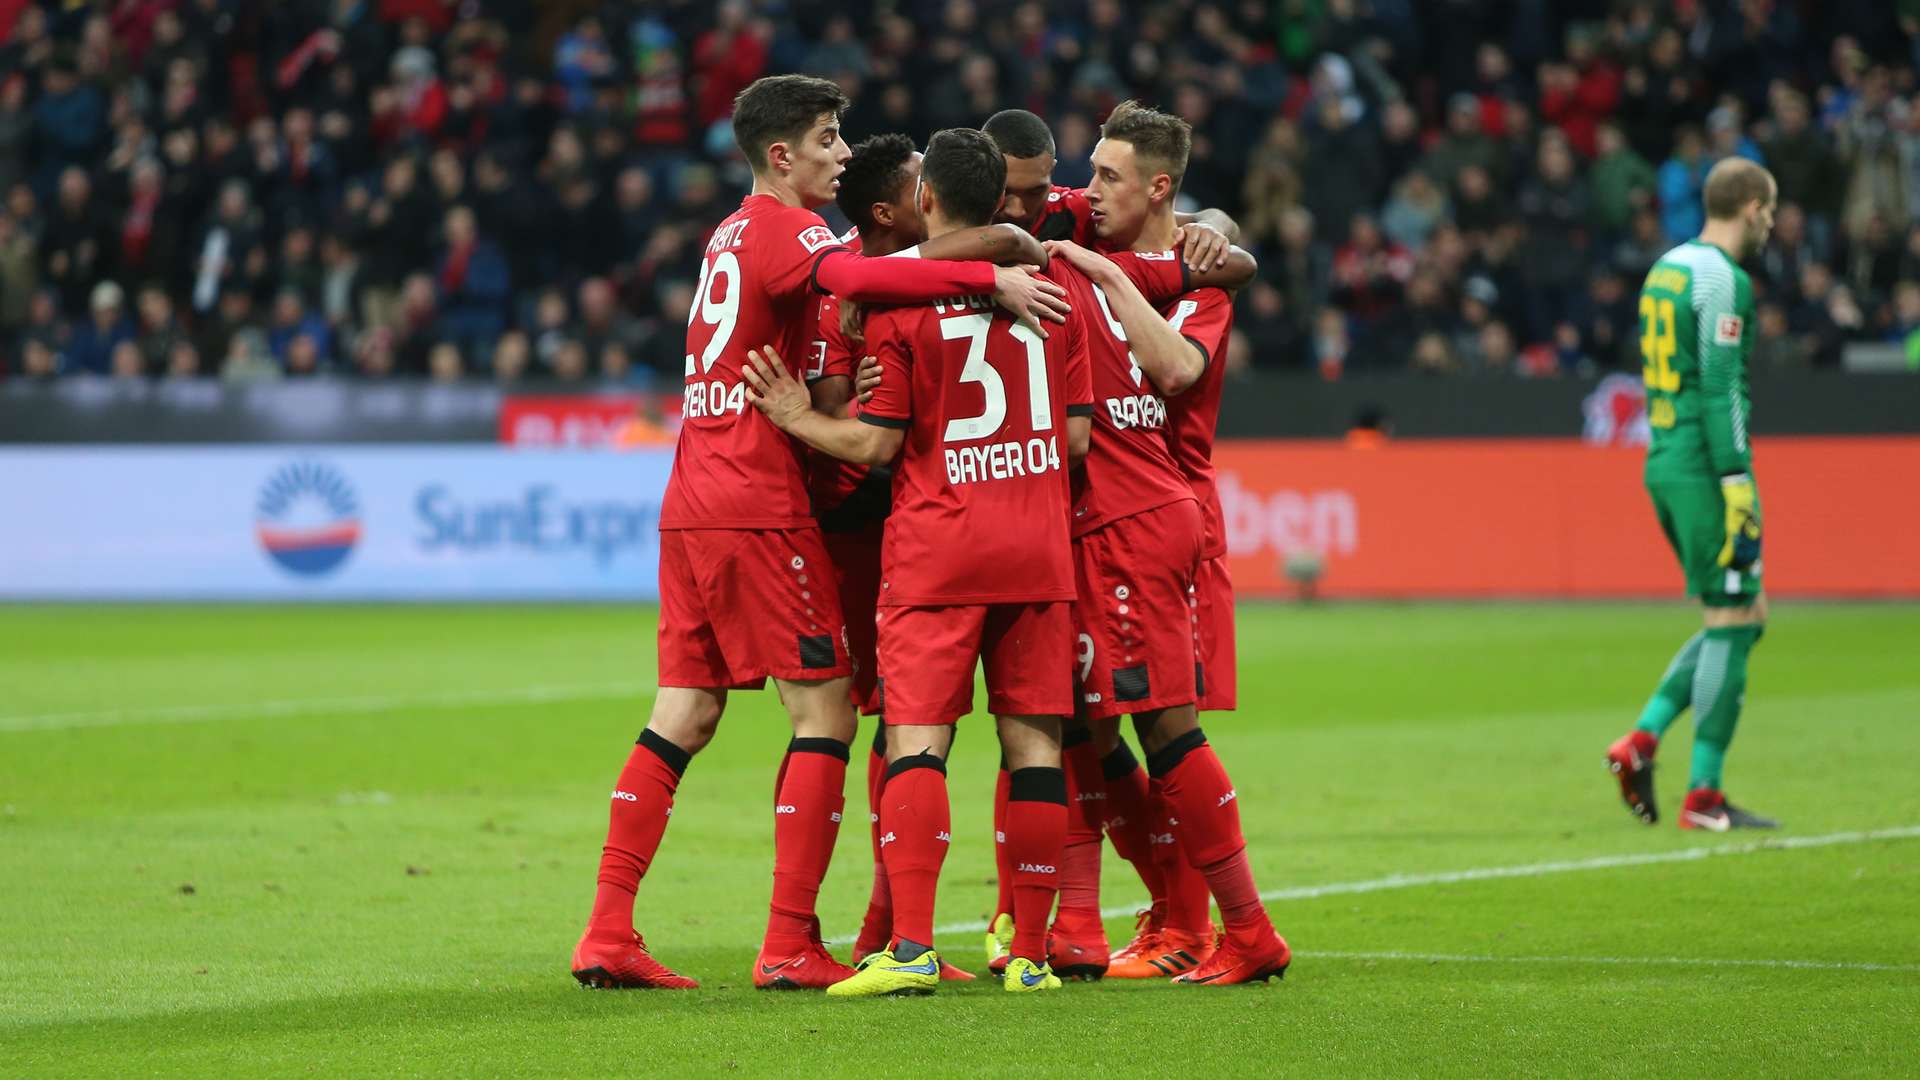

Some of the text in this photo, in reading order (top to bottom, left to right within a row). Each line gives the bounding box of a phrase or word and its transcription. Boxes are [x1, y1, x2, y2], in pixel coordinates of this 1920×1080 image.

[709, 380, 746, 416] 04
[939, 311, 1053, 443] 31
[945, 435, 1061, 485] BAYER 04
[1018, 863, 1057, 874] JAKO
